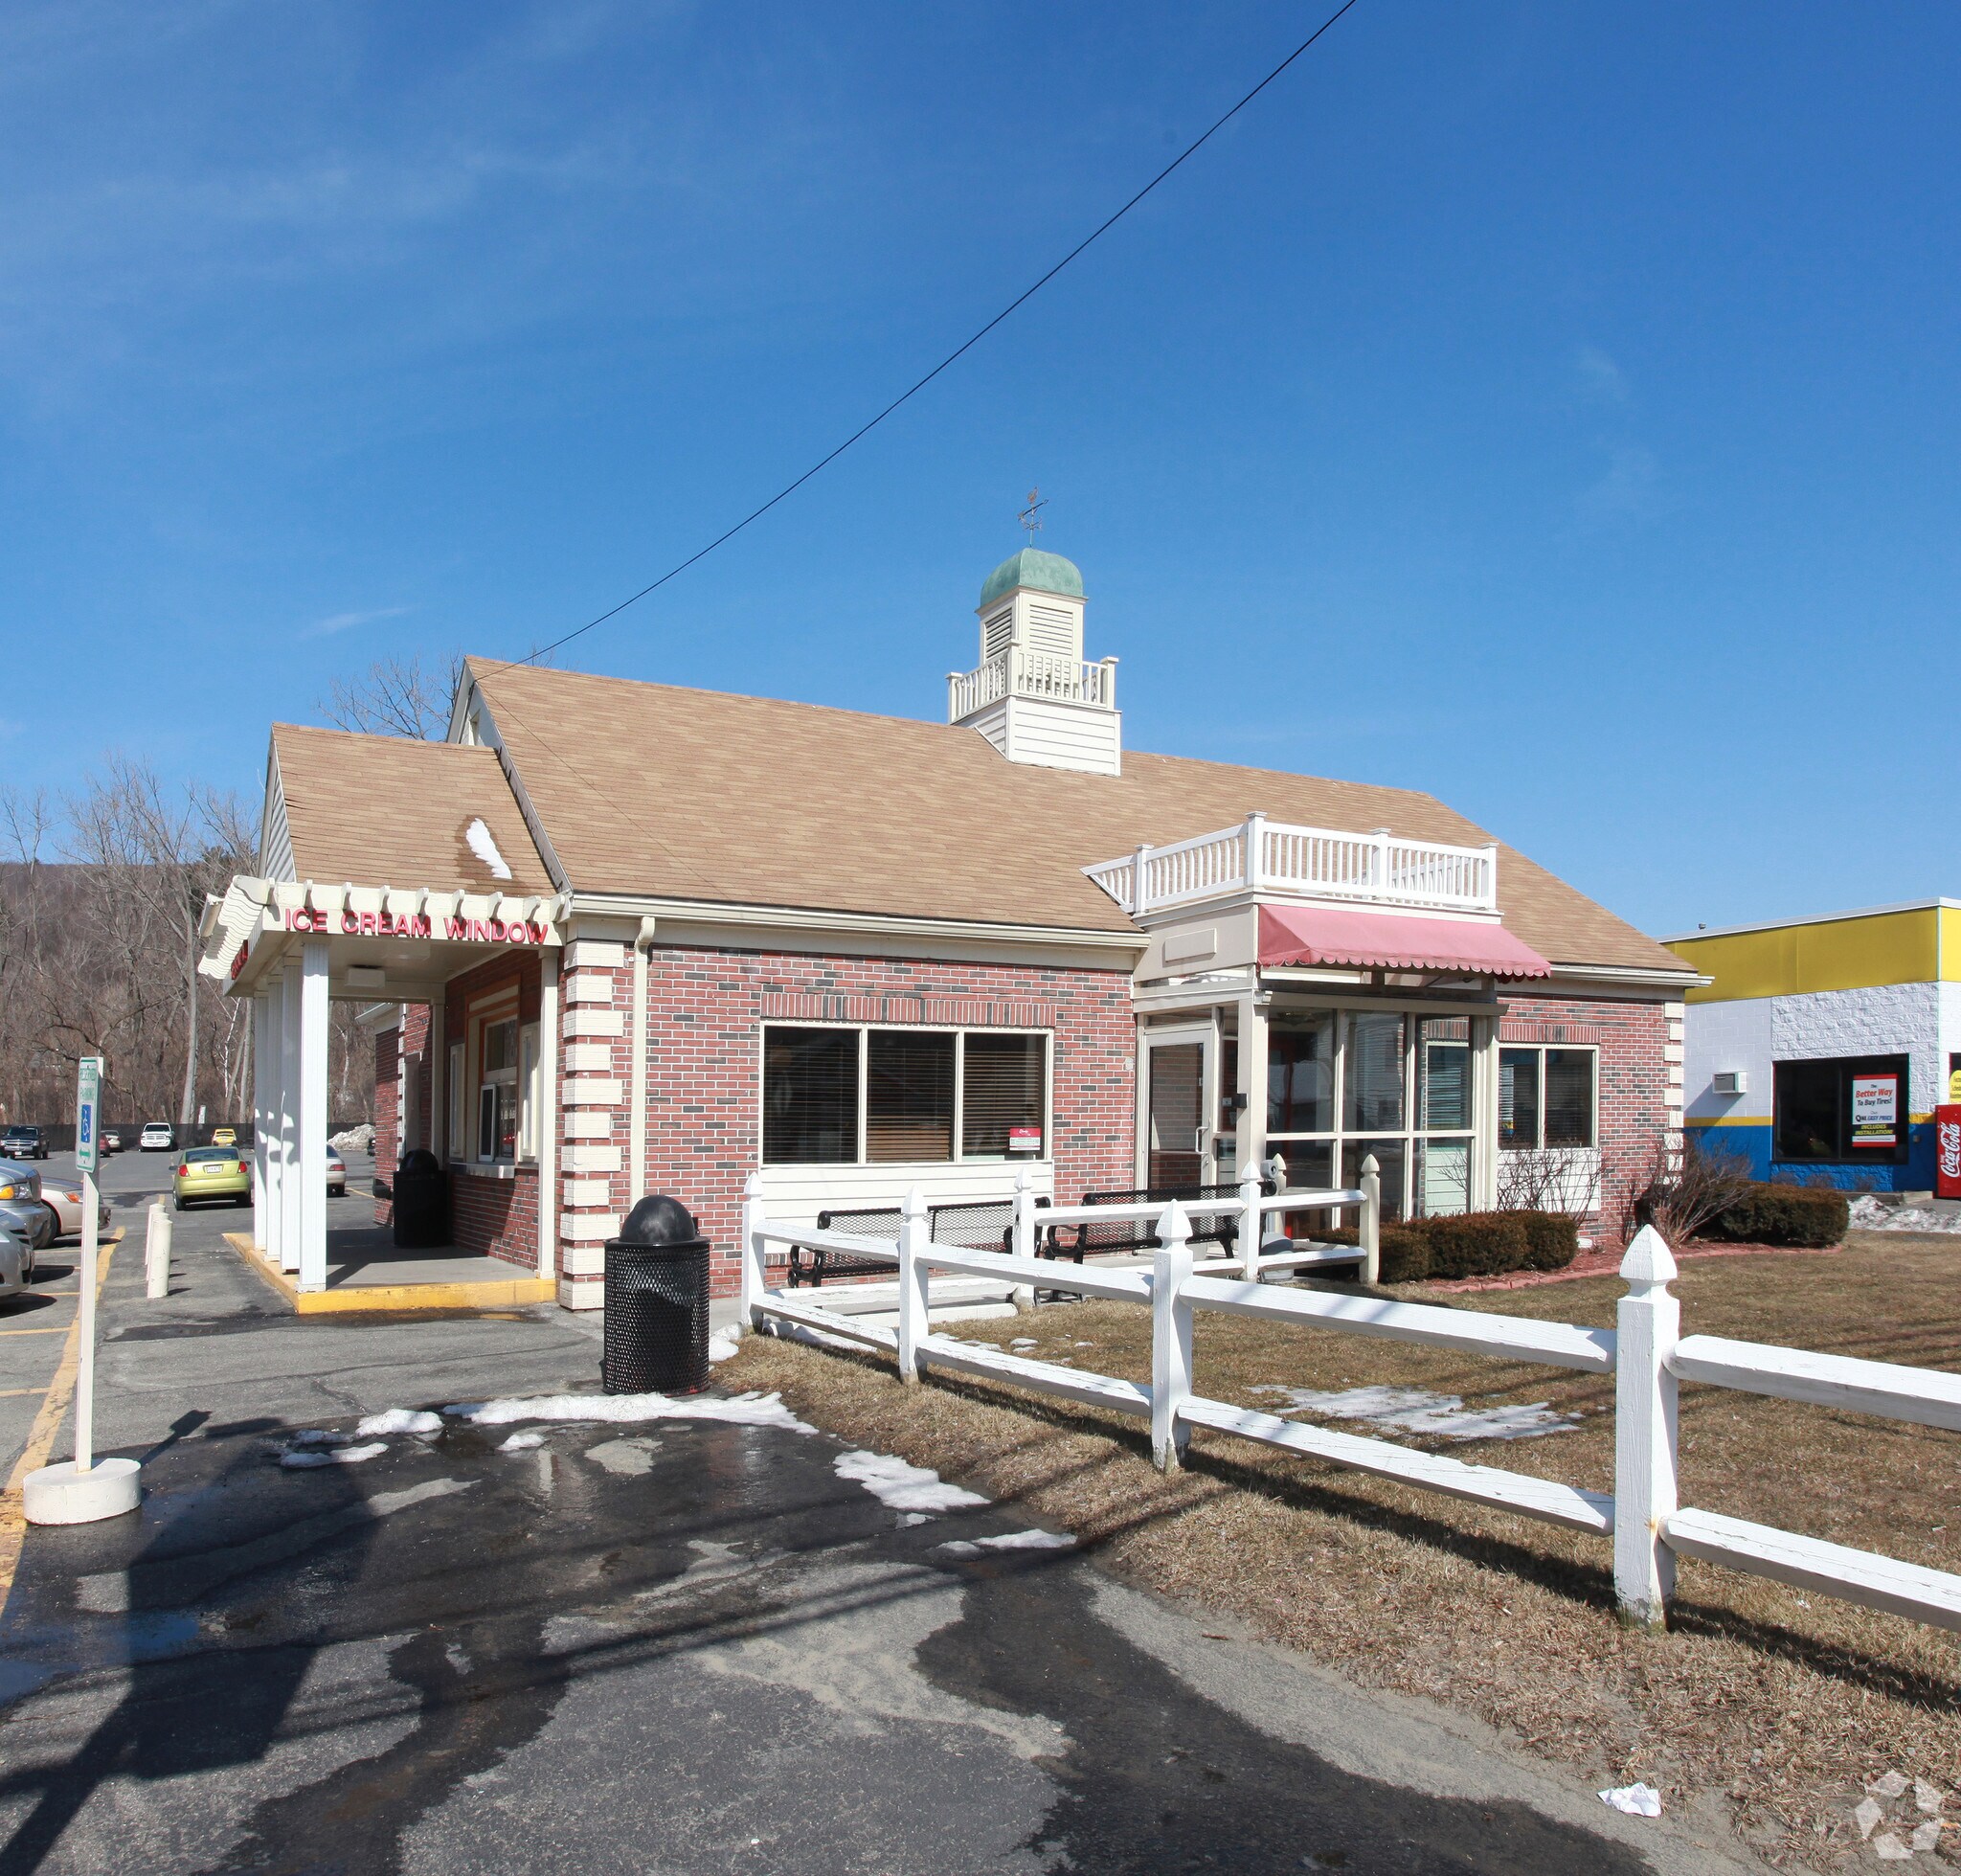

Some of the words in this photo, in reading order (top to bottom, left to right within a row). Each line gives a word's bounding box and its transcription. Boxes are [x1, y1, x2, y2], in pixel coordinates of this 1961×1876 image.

[284, 908, 327, 932] ICE
[340, 911, 431, 938] CREAM
[443, 916, 549, 944] WINDOW
[1856, 1090, 1877, 1098] Better
[1878, 1088, 1893, 1097] Way
[1864, 1098, 1876, 1107] Buy
[1877, 1096, 1893, 1105] Tires!
